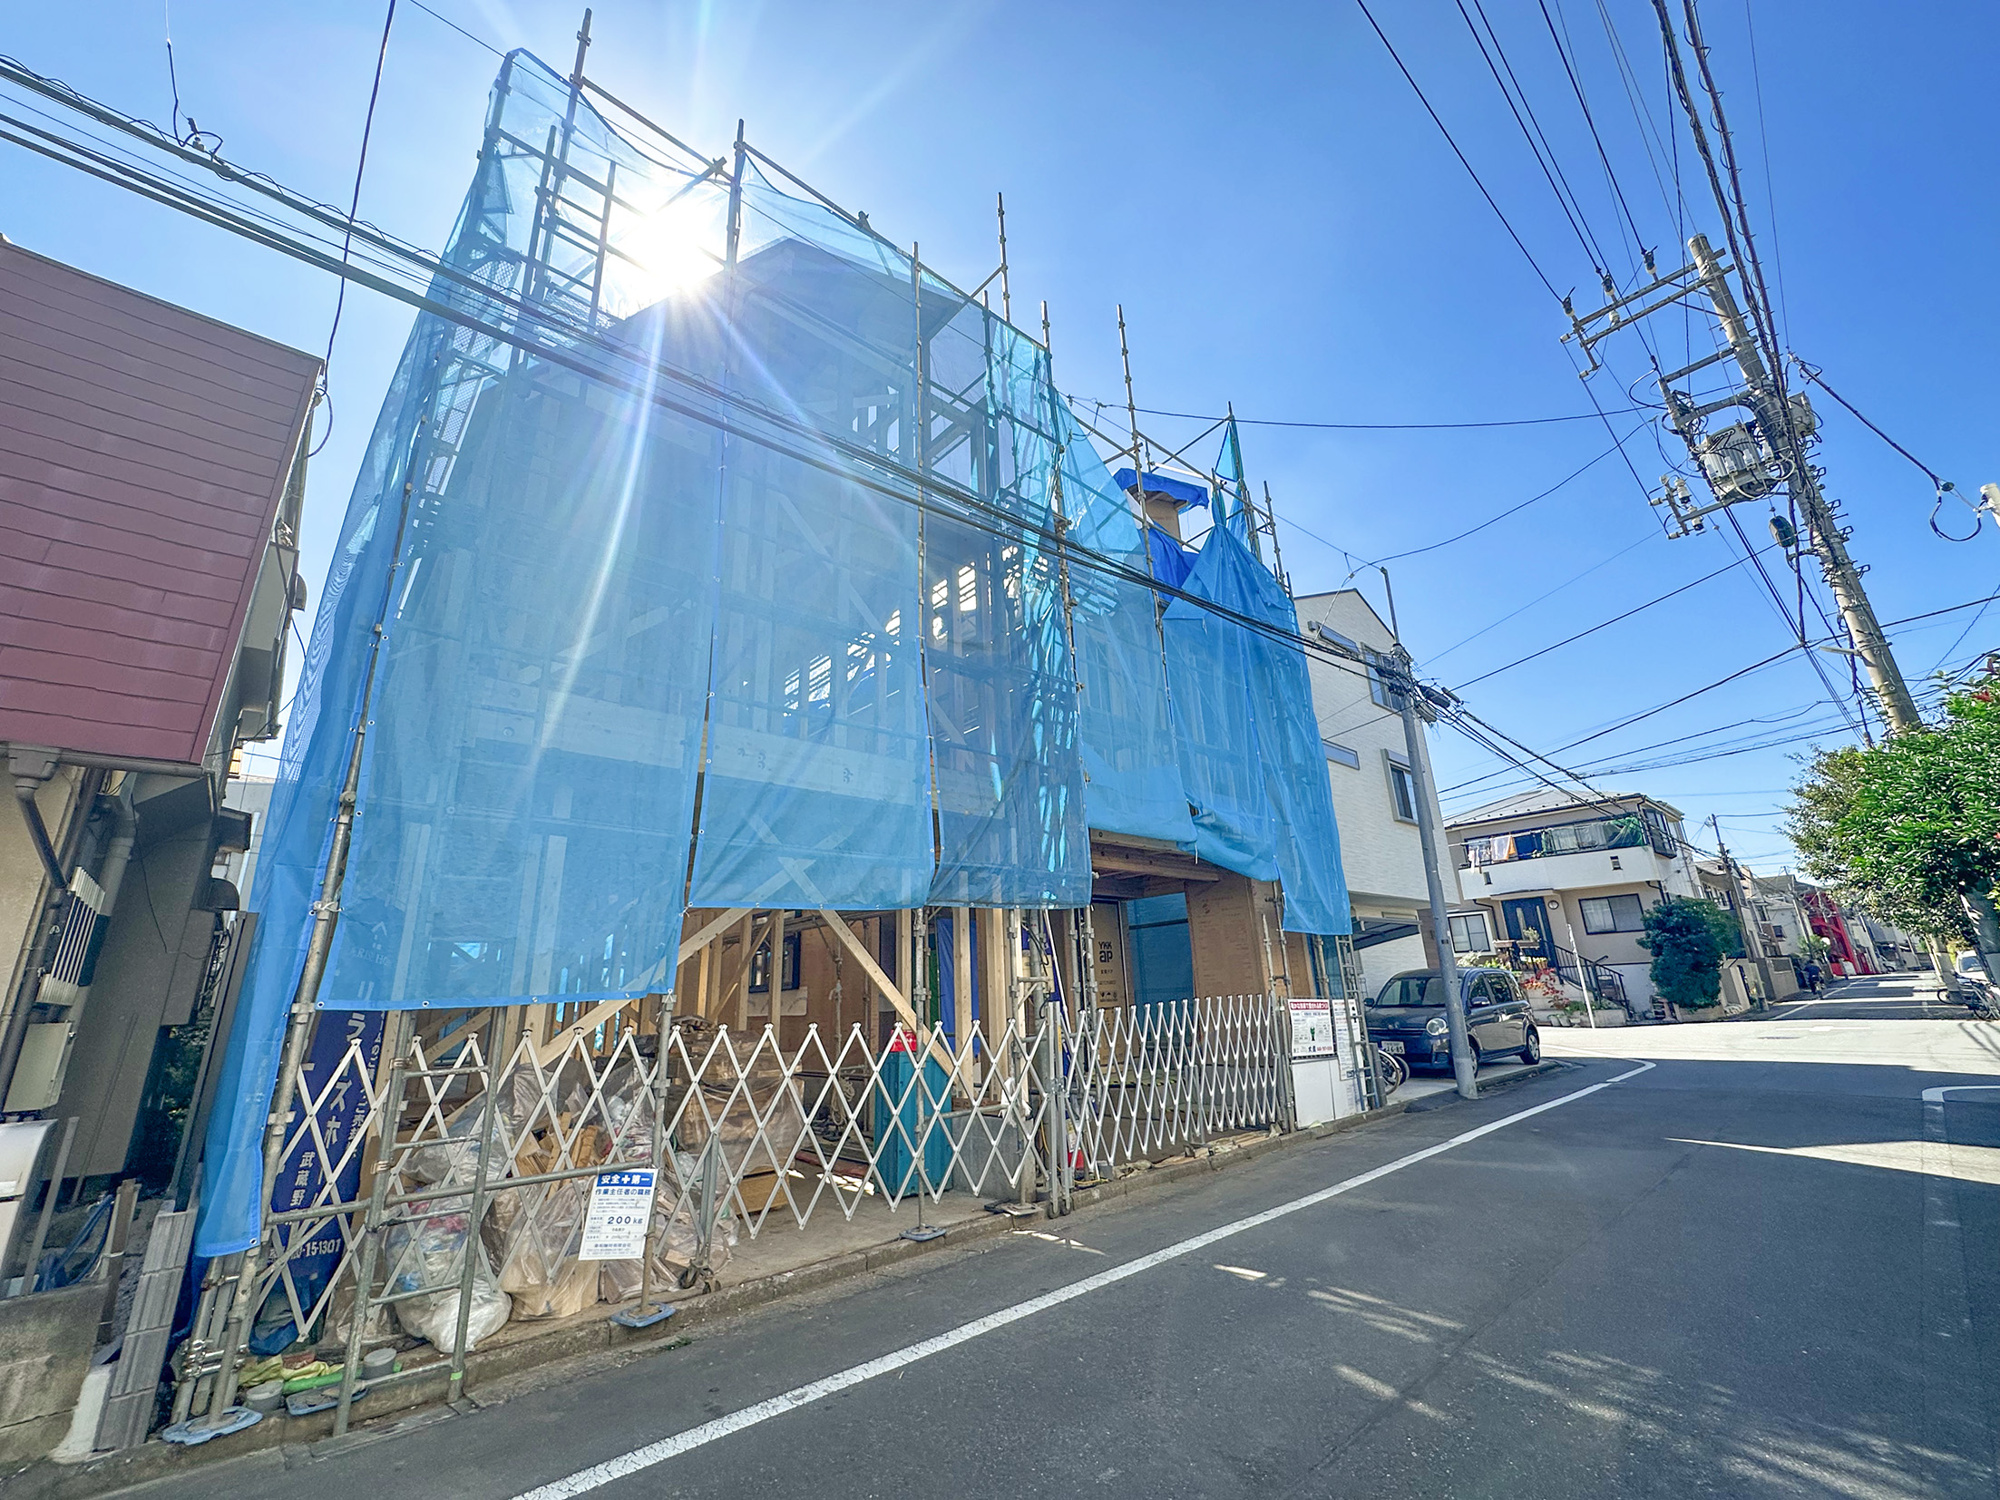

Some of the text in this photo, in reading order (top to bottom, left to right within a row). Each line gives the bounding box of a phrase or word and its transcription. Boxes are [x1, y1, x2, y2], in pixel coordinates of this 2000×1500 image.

[1098, 942, 1113, 950] YKK
[285, 1151, 316, 1225] 武蔵野
[607, 1216, 631, 1224] 200
